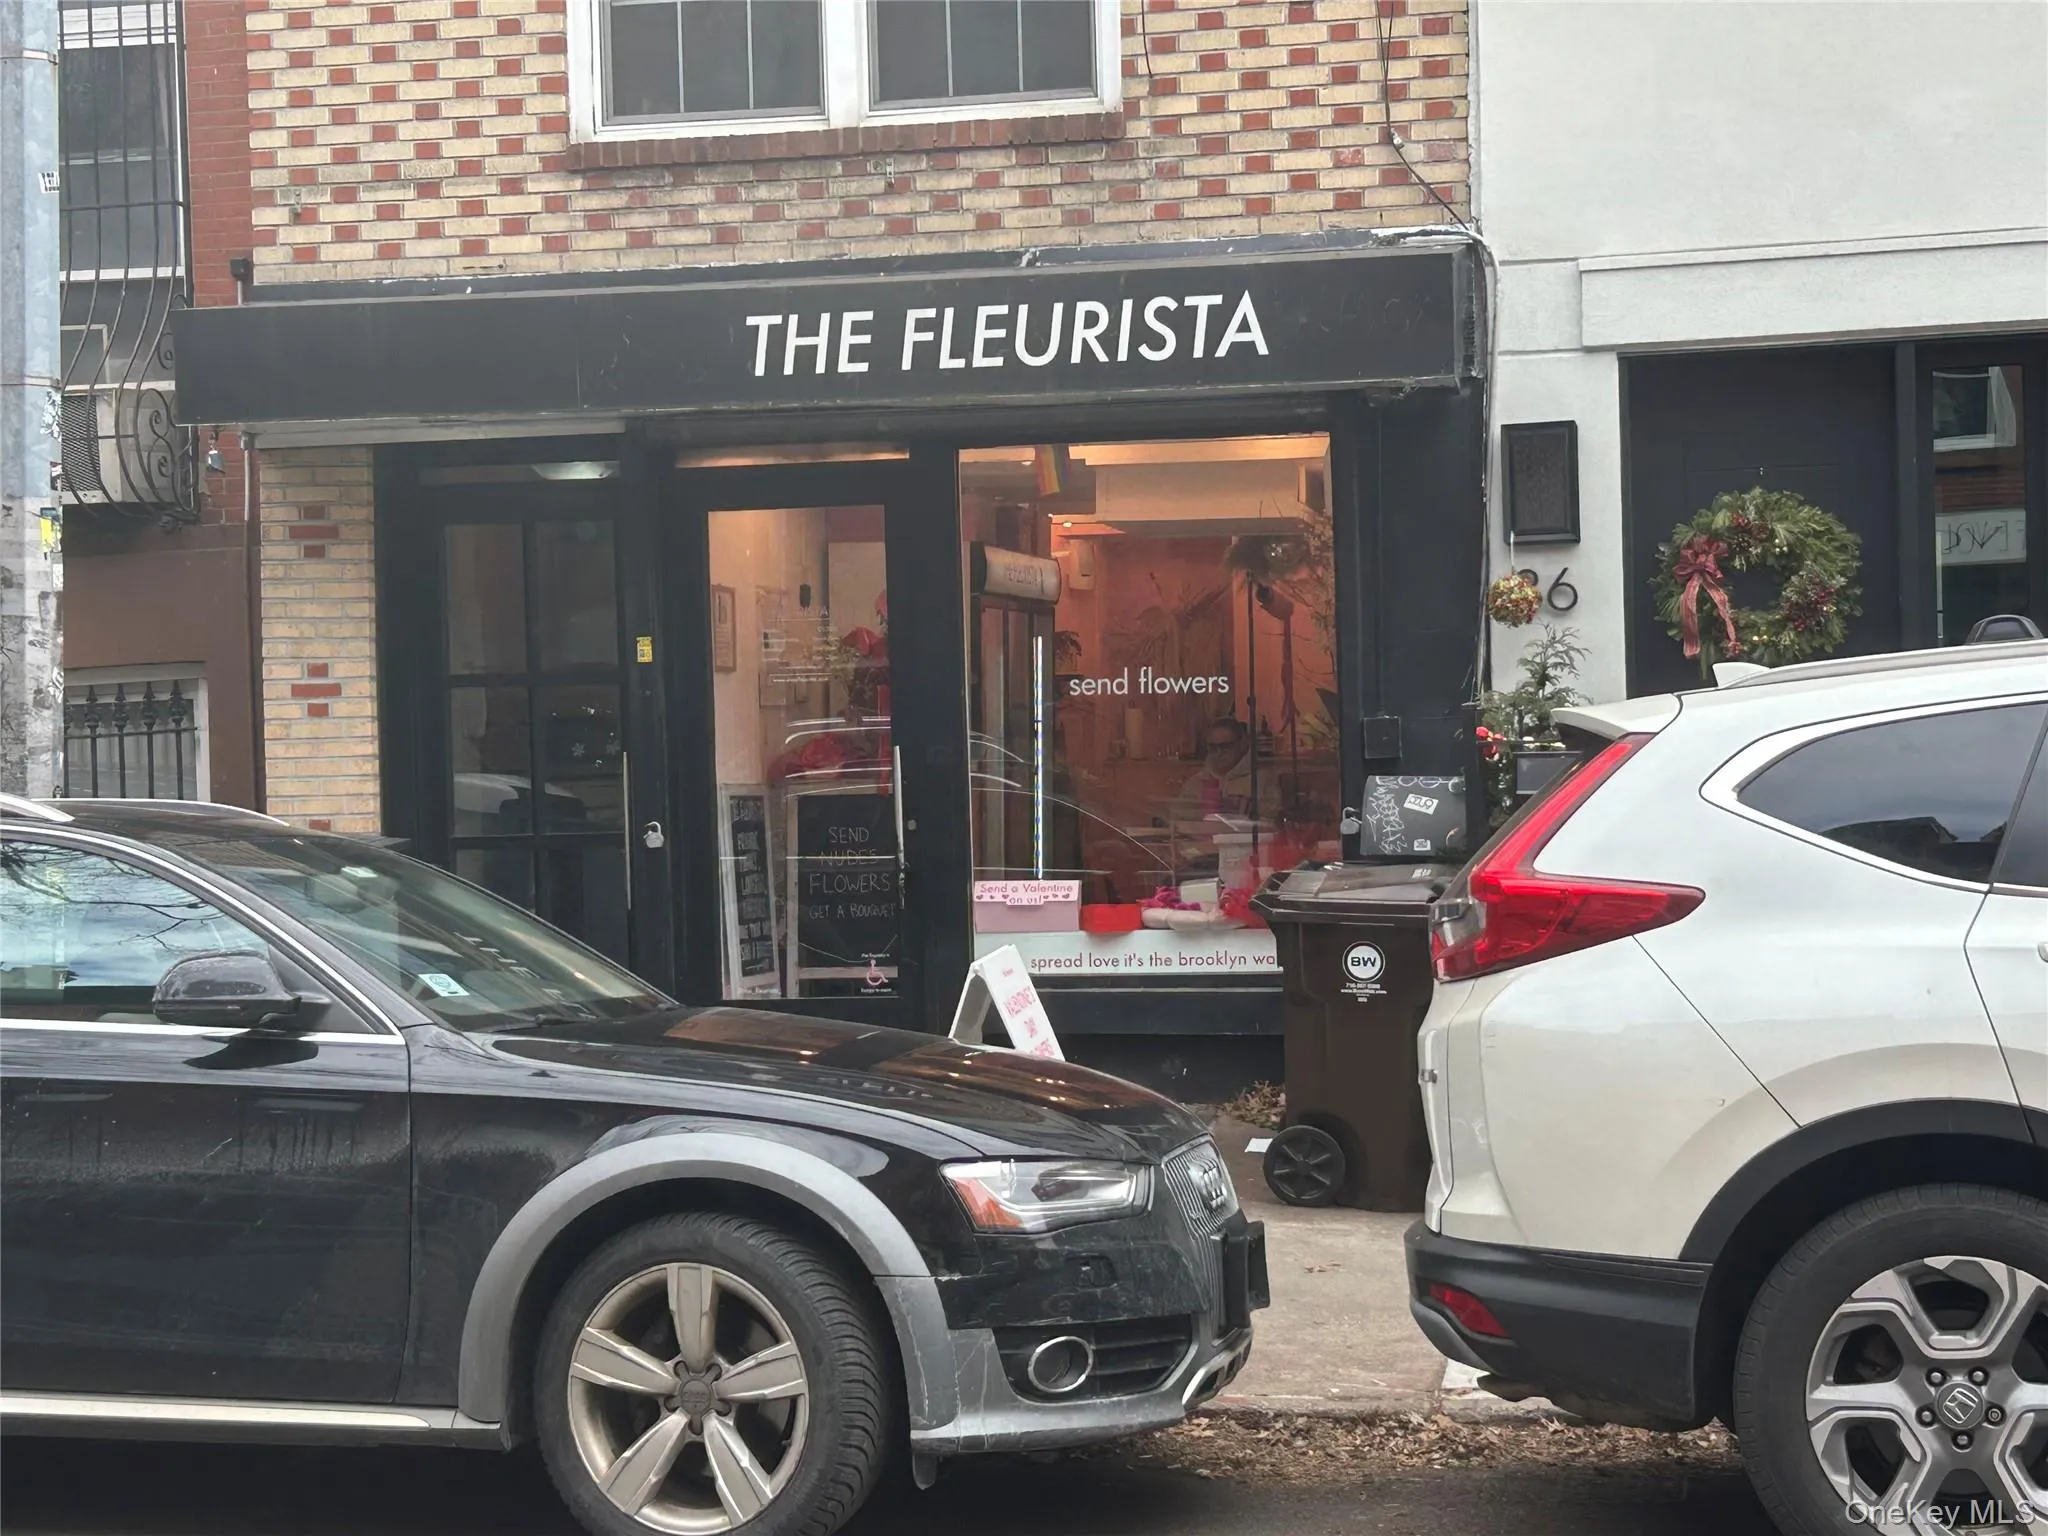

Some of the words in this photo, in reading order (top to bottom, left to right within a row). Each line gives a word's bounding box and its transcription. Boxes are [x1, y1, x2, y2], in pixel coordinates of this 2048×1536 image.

[746, 310, 874, 376] THE
[901, 289, 1269, 371] FLEURISTA
[1069, 667, 1128, 696] send
[1138, 666, 1230, 694] flowers
[828, 826, 870, 844] SEND
[809, 873, 891, 895] FLOWERS
[980, 883, 1008, 894] Send
[1022, 883, 1073, 893] Valentine
[809, 904, 830, 919] GET
[837, 905, 845, 919] A
[1030, 952, 1083, 972] spread
[1089, 952, 1120, 968] love
[1125, 953, 1144, 968] it's
[1149, 952, 1173, 967] the
[1178, 951, 1247, 971] brooklyn
[1253, 955, 1276, 965] wa
[1351, 956, 1377, 967] BW
